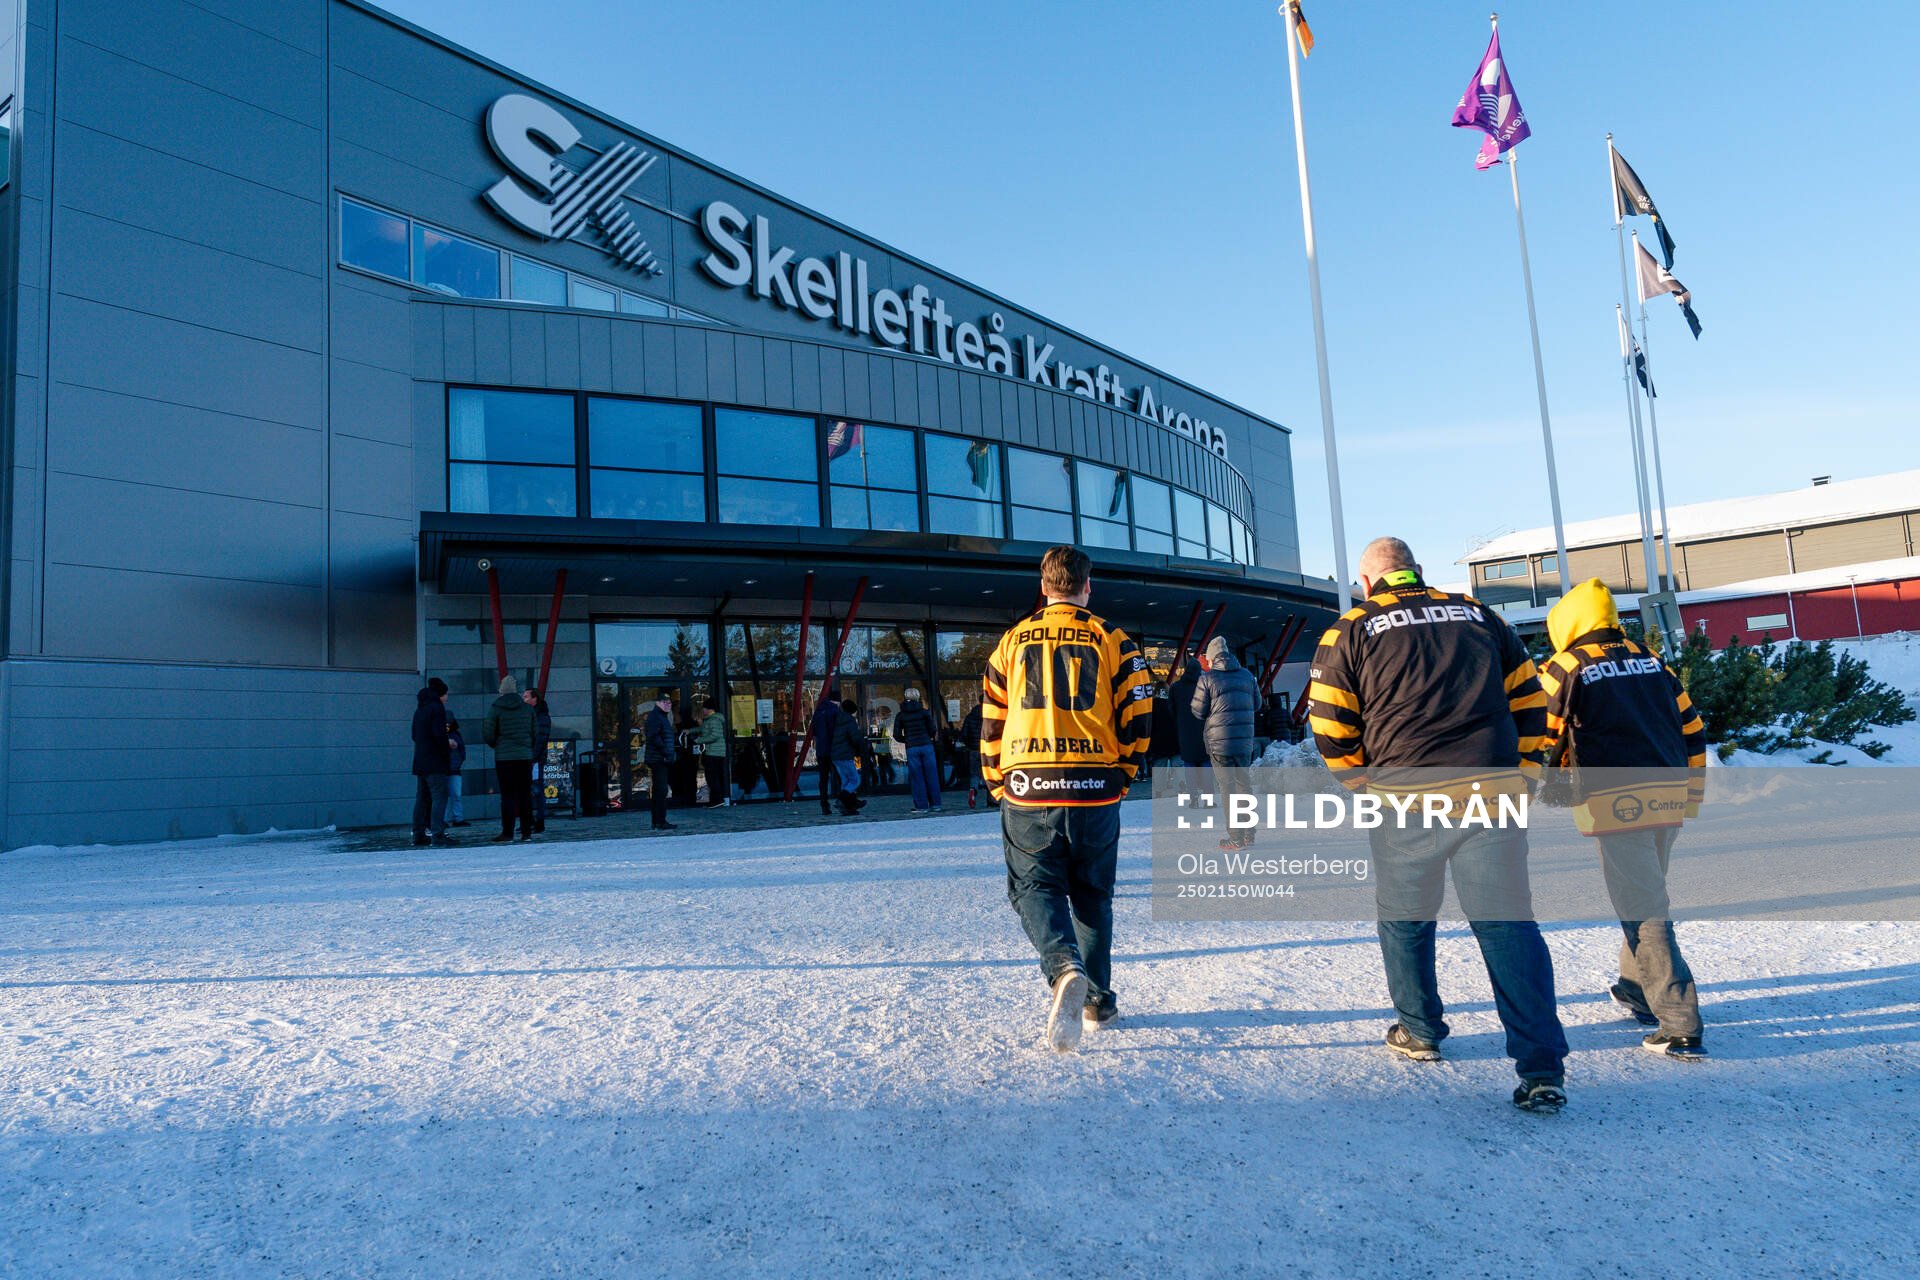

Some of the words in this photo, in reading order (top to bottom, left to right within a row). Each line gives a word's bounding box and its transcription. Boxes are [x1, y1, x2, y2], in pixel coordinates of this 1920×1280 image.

[701, 200, 1014, 377] Skellefteå
[1023, 333, 1126, 408] Kraft
[1136, 384, 1229, 461] Arena
[1371, 605, 1485, 636] BOLIDEN
[1018, 626, 1103, 646] BOLIDEN
[1020, 643, 1100, 712] 10
[1586, 656, 1662, 683] BOLIDEN
[1031, 776, 1105, 790] Contractor
